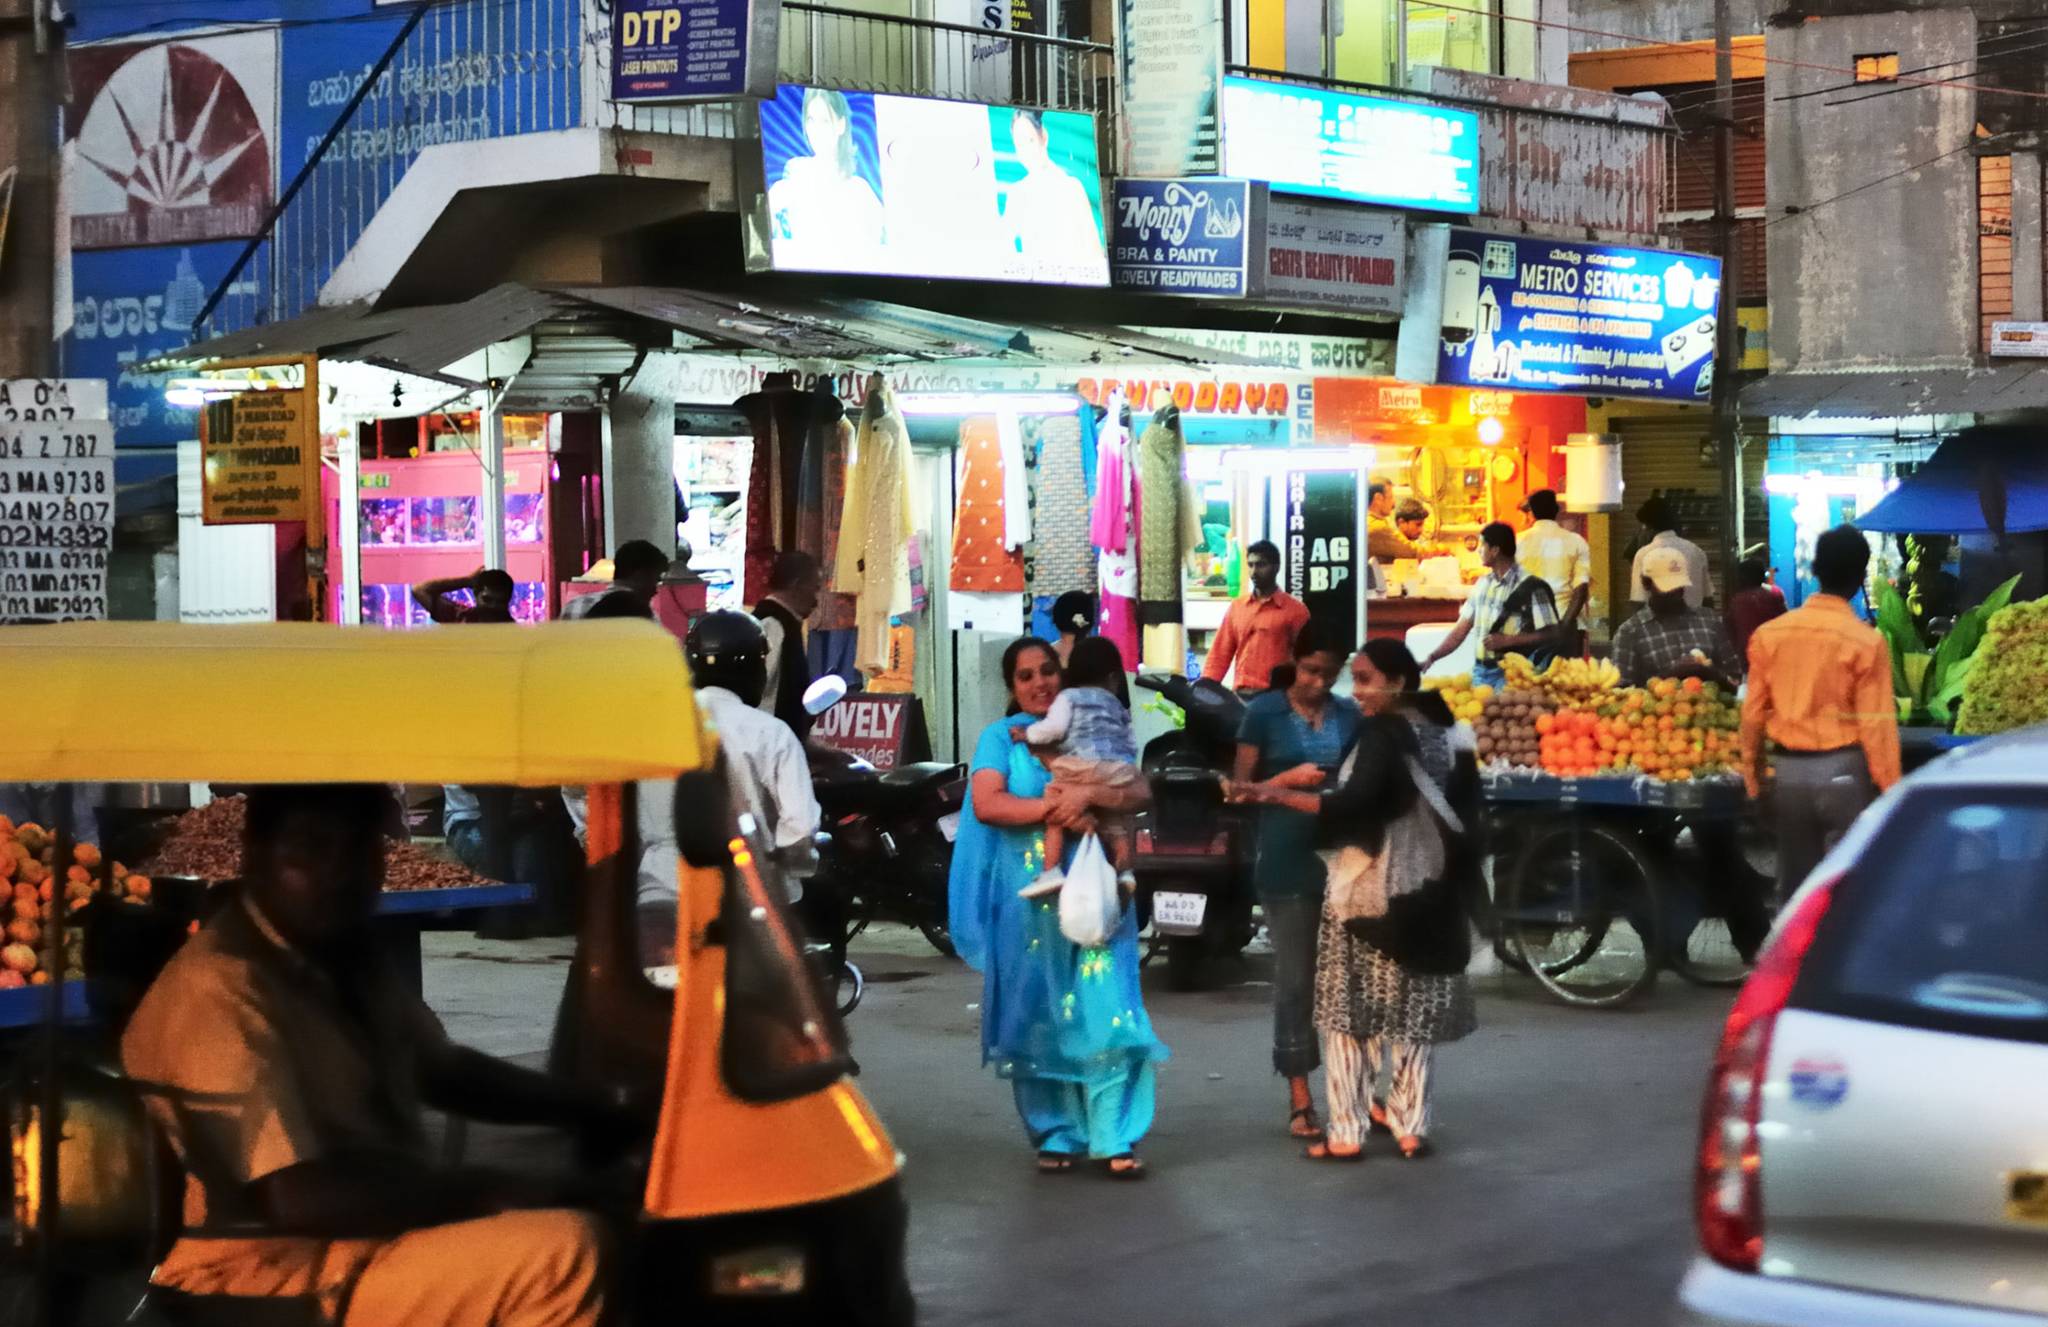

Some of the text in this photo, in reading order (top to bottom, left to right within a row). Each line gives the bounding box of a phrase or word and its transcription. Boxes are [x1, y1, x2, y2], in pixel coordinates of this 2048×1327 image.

[622, 9, 682, 47] DTP
[621, 59, 679, 76] LASER PRINTOUTS
[1117, 247, 1218, 263] BRA & PANTY
[1305, 251, 1344, 282] BEAUTY
[1116, 270, 1157, 285] LOVELY
[1161, 271, 1238, 289] READYMADES
[1520, 263, 1661, 302] METRO SERVICES
[63, 434, 98, 457] 787
[18, 471, 48, 493] MA
[54, 470, 105, 494] 9738
[1310, 537, 1350, 562] AG
[1309, 566, 1349, 592] BP
